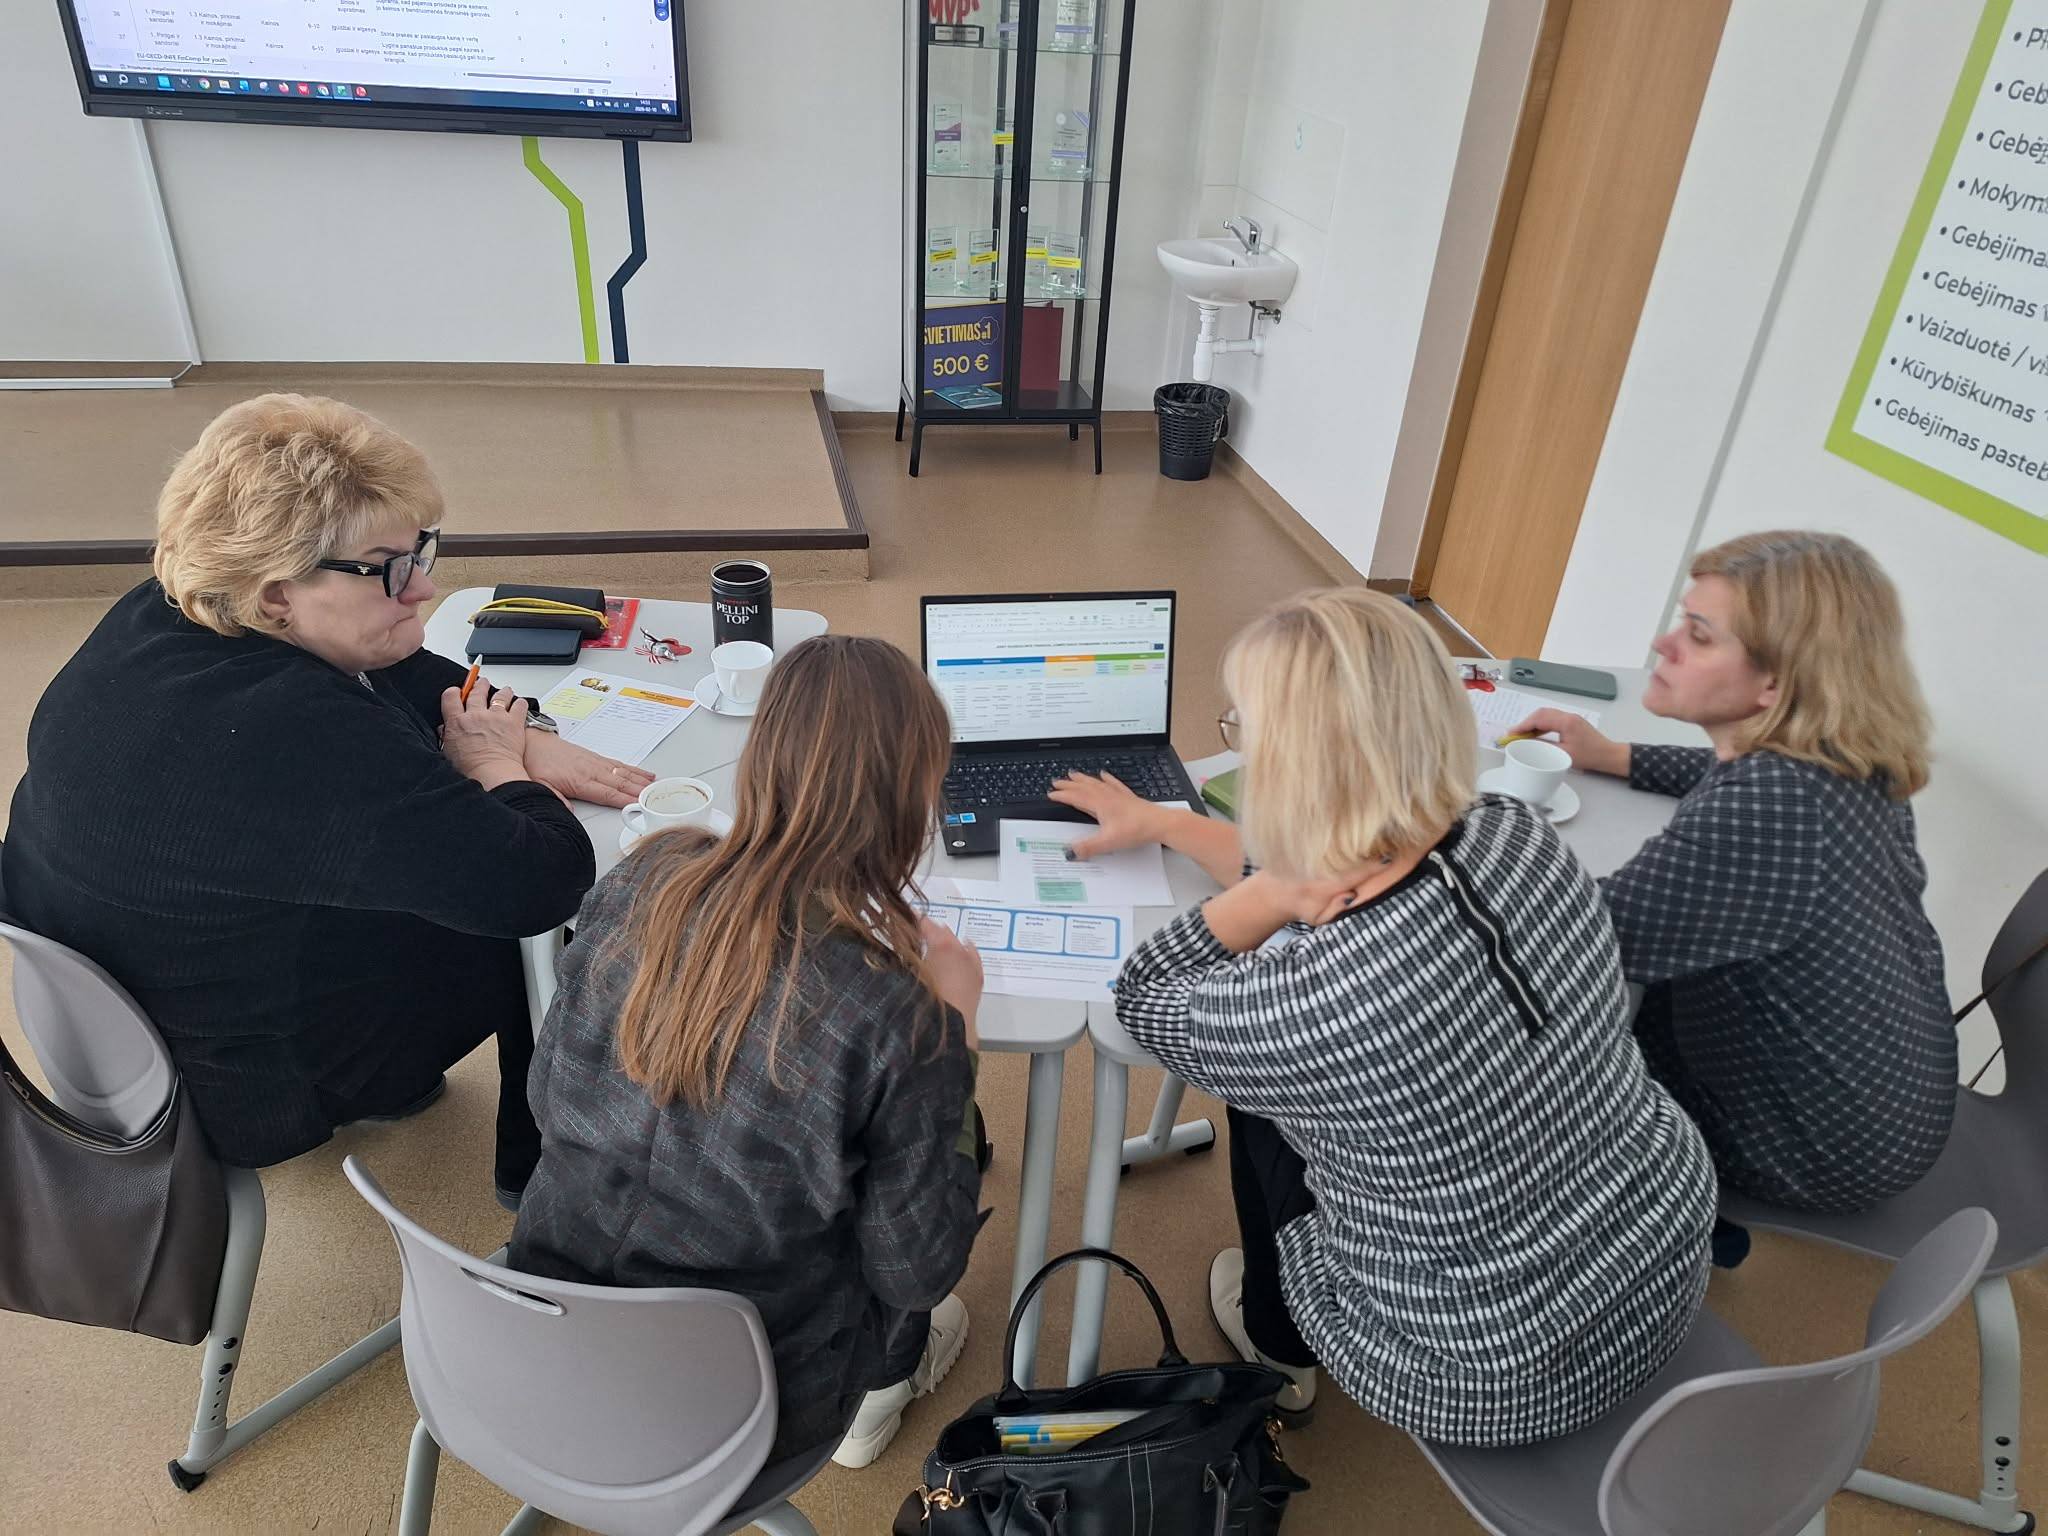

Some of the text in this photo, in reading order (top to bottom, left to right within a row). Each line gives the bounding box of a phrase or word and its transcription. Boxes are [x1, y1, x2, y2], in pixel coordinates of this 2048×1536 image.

[1934, 271, 2038, 318] Gebėjimas
[1918, 313, 2011, 362] Vaizduotė
[933, 353, 989, 377] 500 €
[1900, 356, 2036, 424] Kūrybiškumas
[1885, 398, 1981, 452] Gebėjimas
[716, 601, 758, 616] PELLINI
[723, 613, 750, 625] TOP
